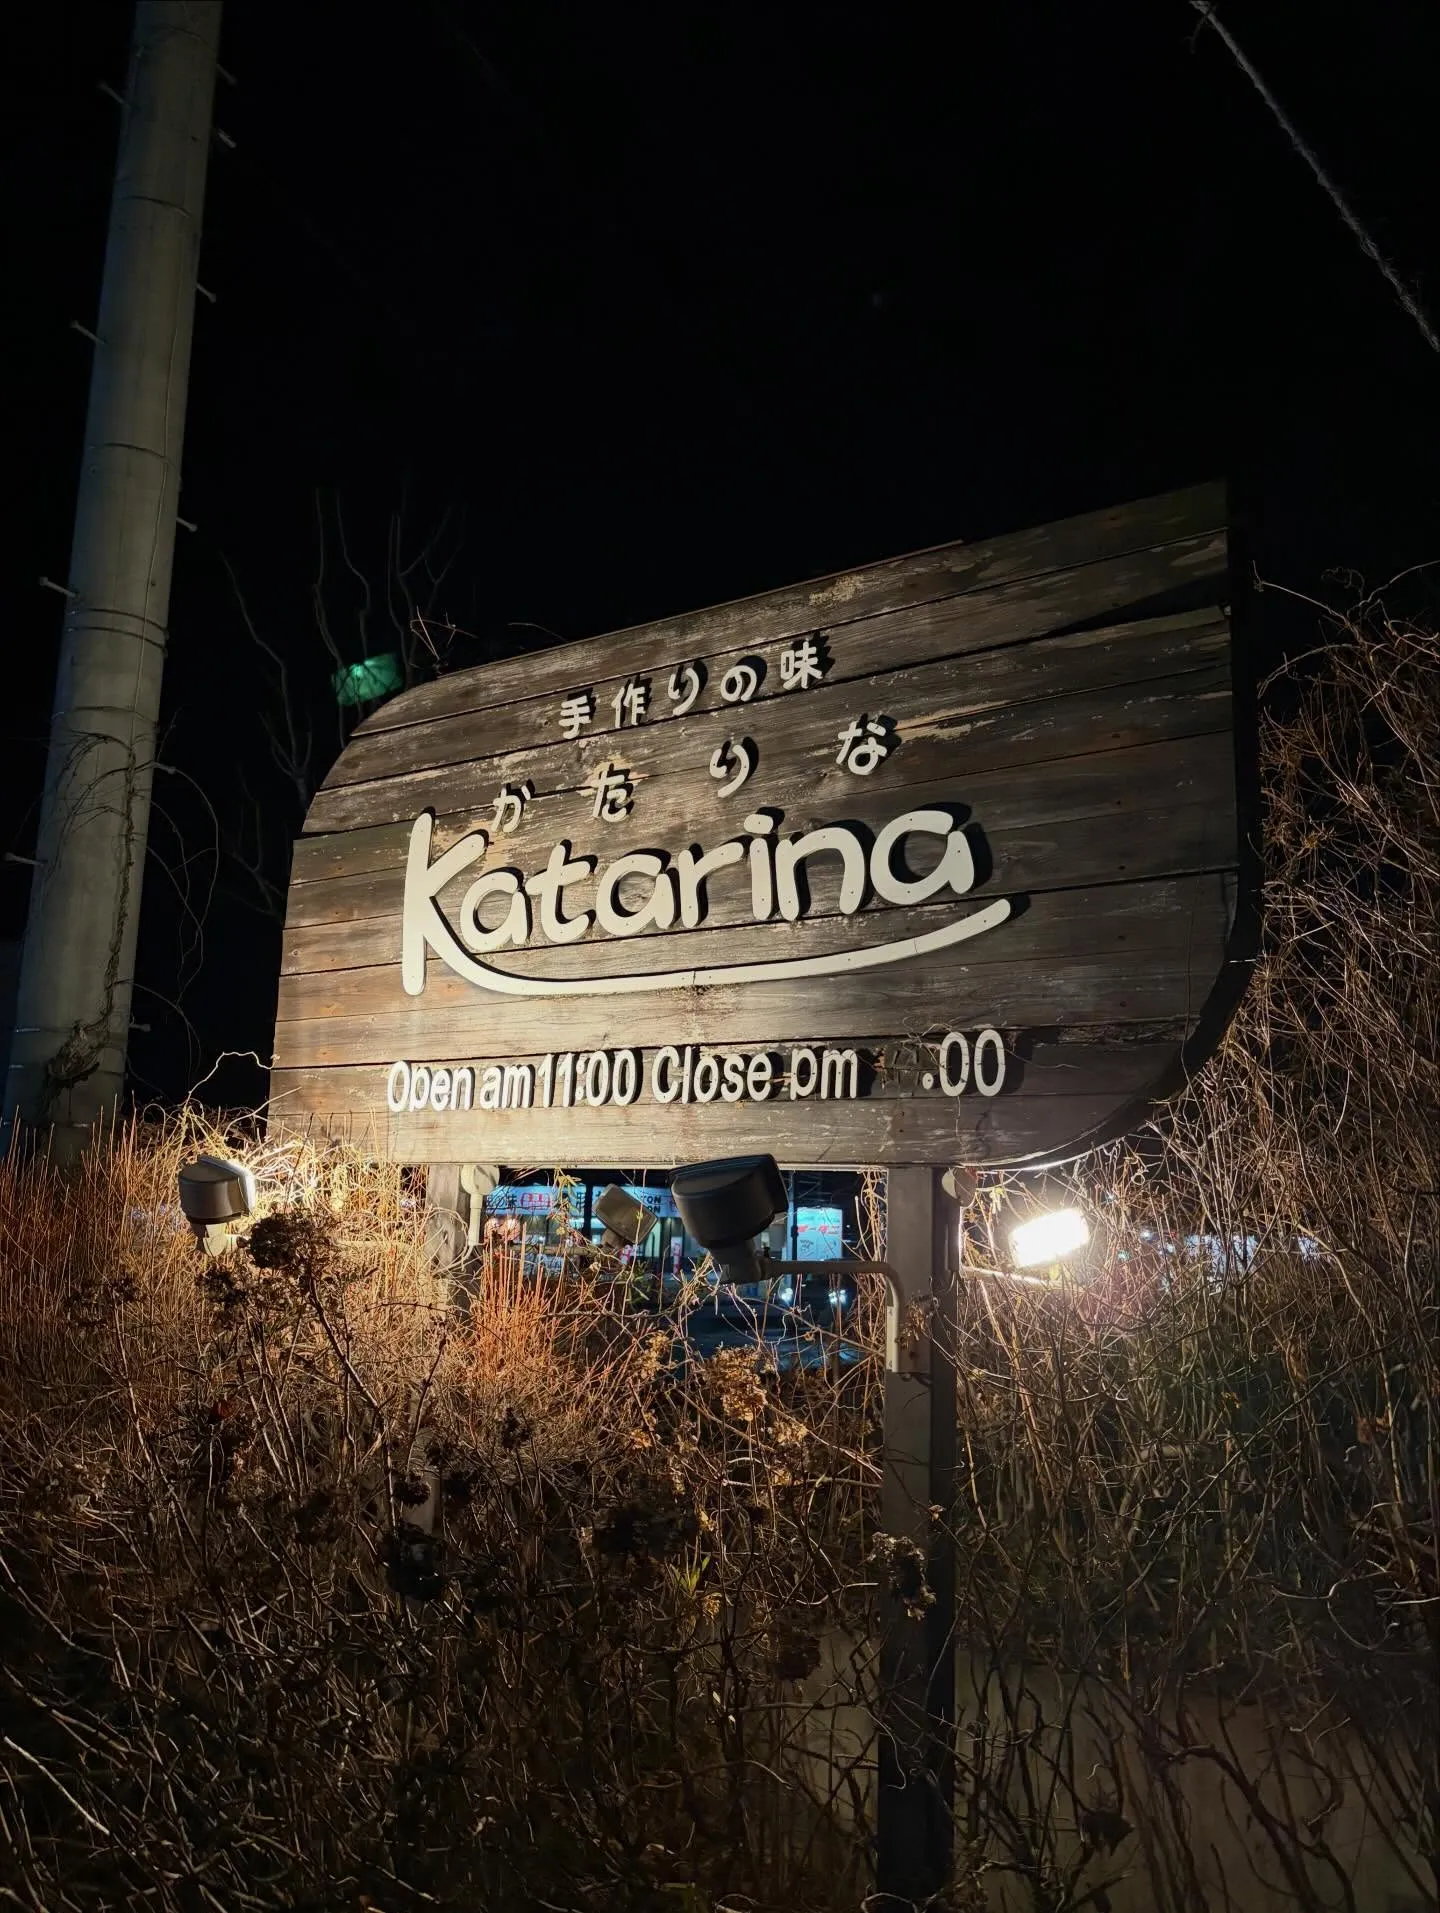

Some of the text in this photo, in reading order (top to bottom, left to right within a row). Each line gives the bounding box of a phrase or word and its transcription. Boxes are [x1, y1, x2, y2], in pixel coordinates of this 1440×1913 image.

[558, 641, 823, 740] 手作りの味
[402, 809, 1012, 996] Katarina
[387, 1060, 473, 1112] Open
[479, 1065, 532, 1109] am
[537, 1049, 636, 1107] 11:00
[651, 1045, 772, 1104] Close
[790, 1047, 858, 1101] pm
